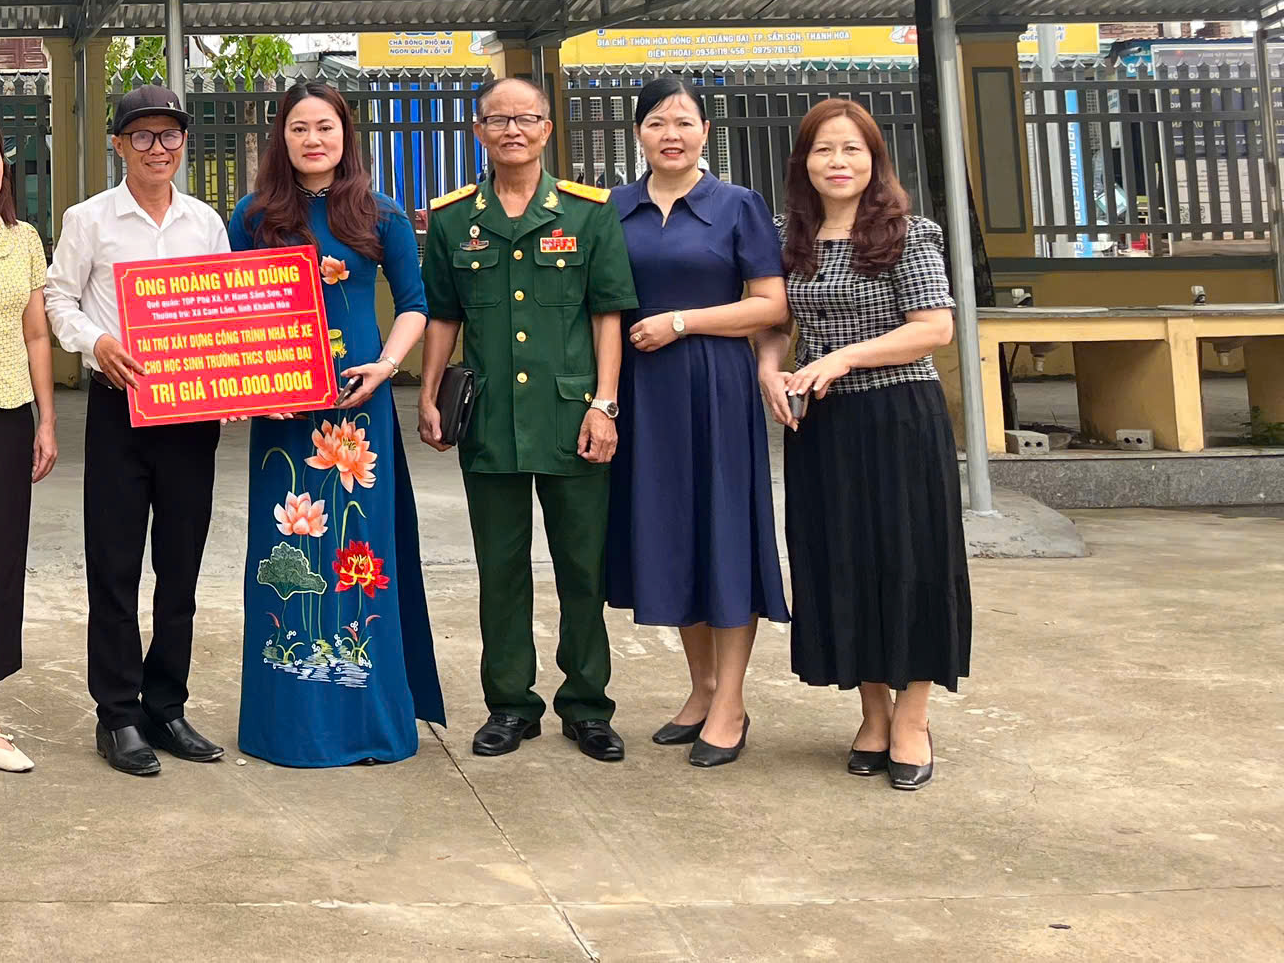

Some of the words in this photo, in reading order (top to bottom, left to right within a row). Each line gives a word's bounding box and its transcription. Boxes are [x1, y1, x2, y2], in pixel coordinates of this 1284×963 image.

[806, 31, 832, 40] THANH
[135, 277, 166, 296] ÔNG
[170, 273, 220, 293] HOÀNG
[223, 268, 255, 288] VĂN
[258, 264, 300, 285] DŨNG
[146, 300, 160, 309] Quê
[182, 297, 195, 306] TDP
[232, 292, 248, 301] Nam
[283, 288, 293, 296] TH
[203, 307, 219, 316] Cam
[253, 301, 275, 311] Khánh
[152, 335, 170, 353] TRỢ
[170, 332, 188, 349] XÂY
[215, 328, 240, 346] CÔNG
[240, 326, 267, 343] TRÌNH
[268, 323, 287, 340] NHÀ
[301, 324, 313, 337] XE
[144, 360, 162, 374] CHO
[163, 358, 182, 375] HỌC
[183, 356, 204, 372] SINH
[205, 351, 240, 369] TRƯỜNG
[242, 350, 264, 365] THCS
[265, 345, 295, 363] QUẢNG
[150, 383, 177, 407] TRỊ
[179, 376, 207, 402] GIÁ
[210, 370, 313, 399] 100.000.000đ
